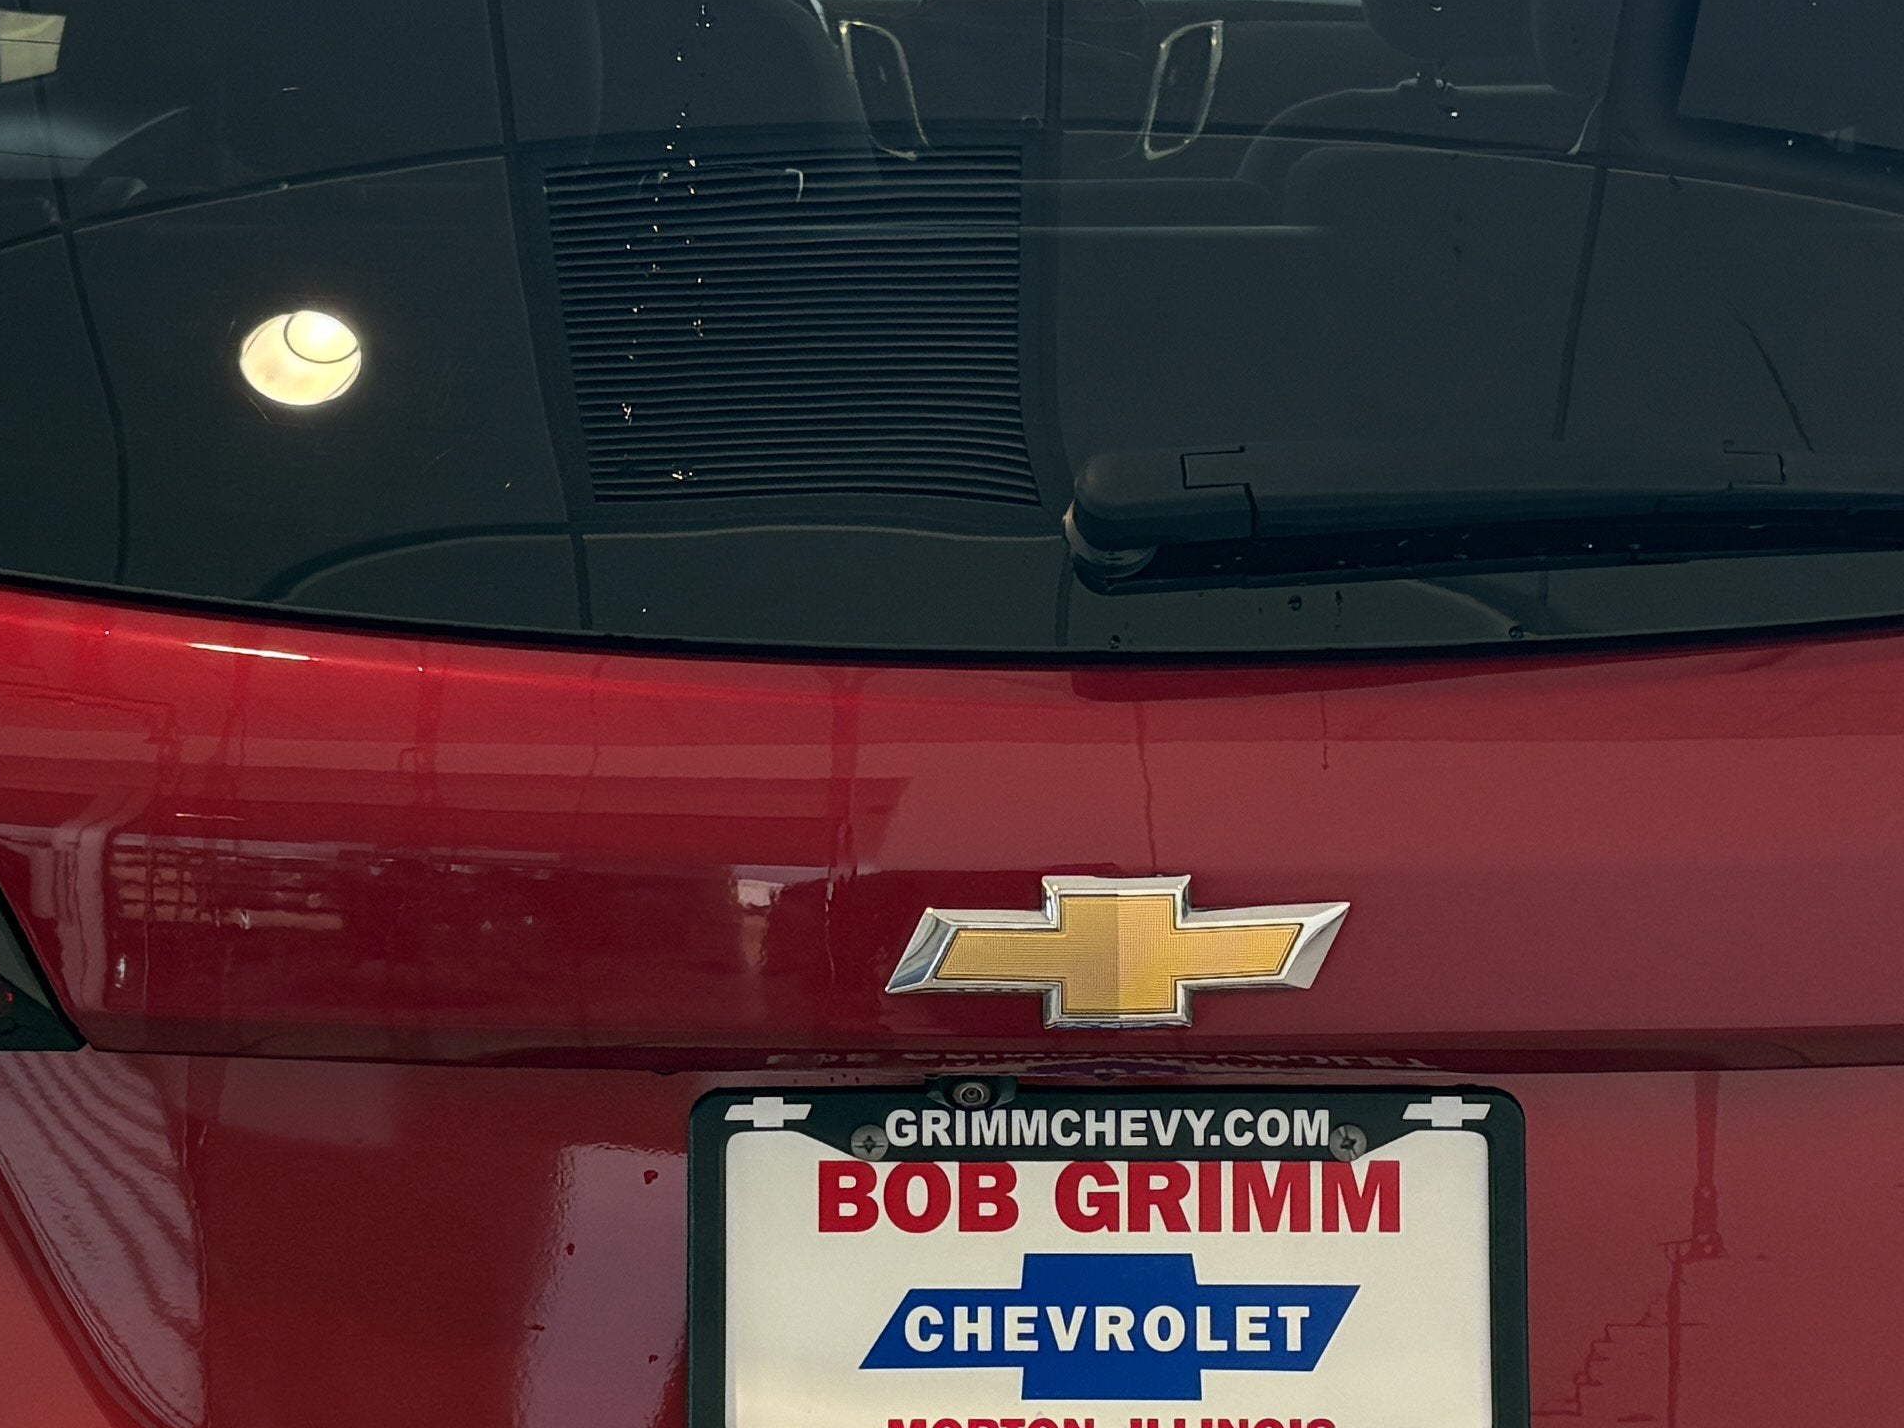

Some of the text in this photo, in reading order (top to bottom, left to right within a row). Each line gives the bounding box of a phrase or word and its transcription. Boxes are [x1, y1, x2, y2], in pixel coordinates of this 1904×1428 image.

[885, 1108, 1330, 1148] GRIMMCHEVY.COM
[818, 1160, 1402, 1234] BOB GRIMM
[903, 1304, 1312, 1353] CHEVROLET
